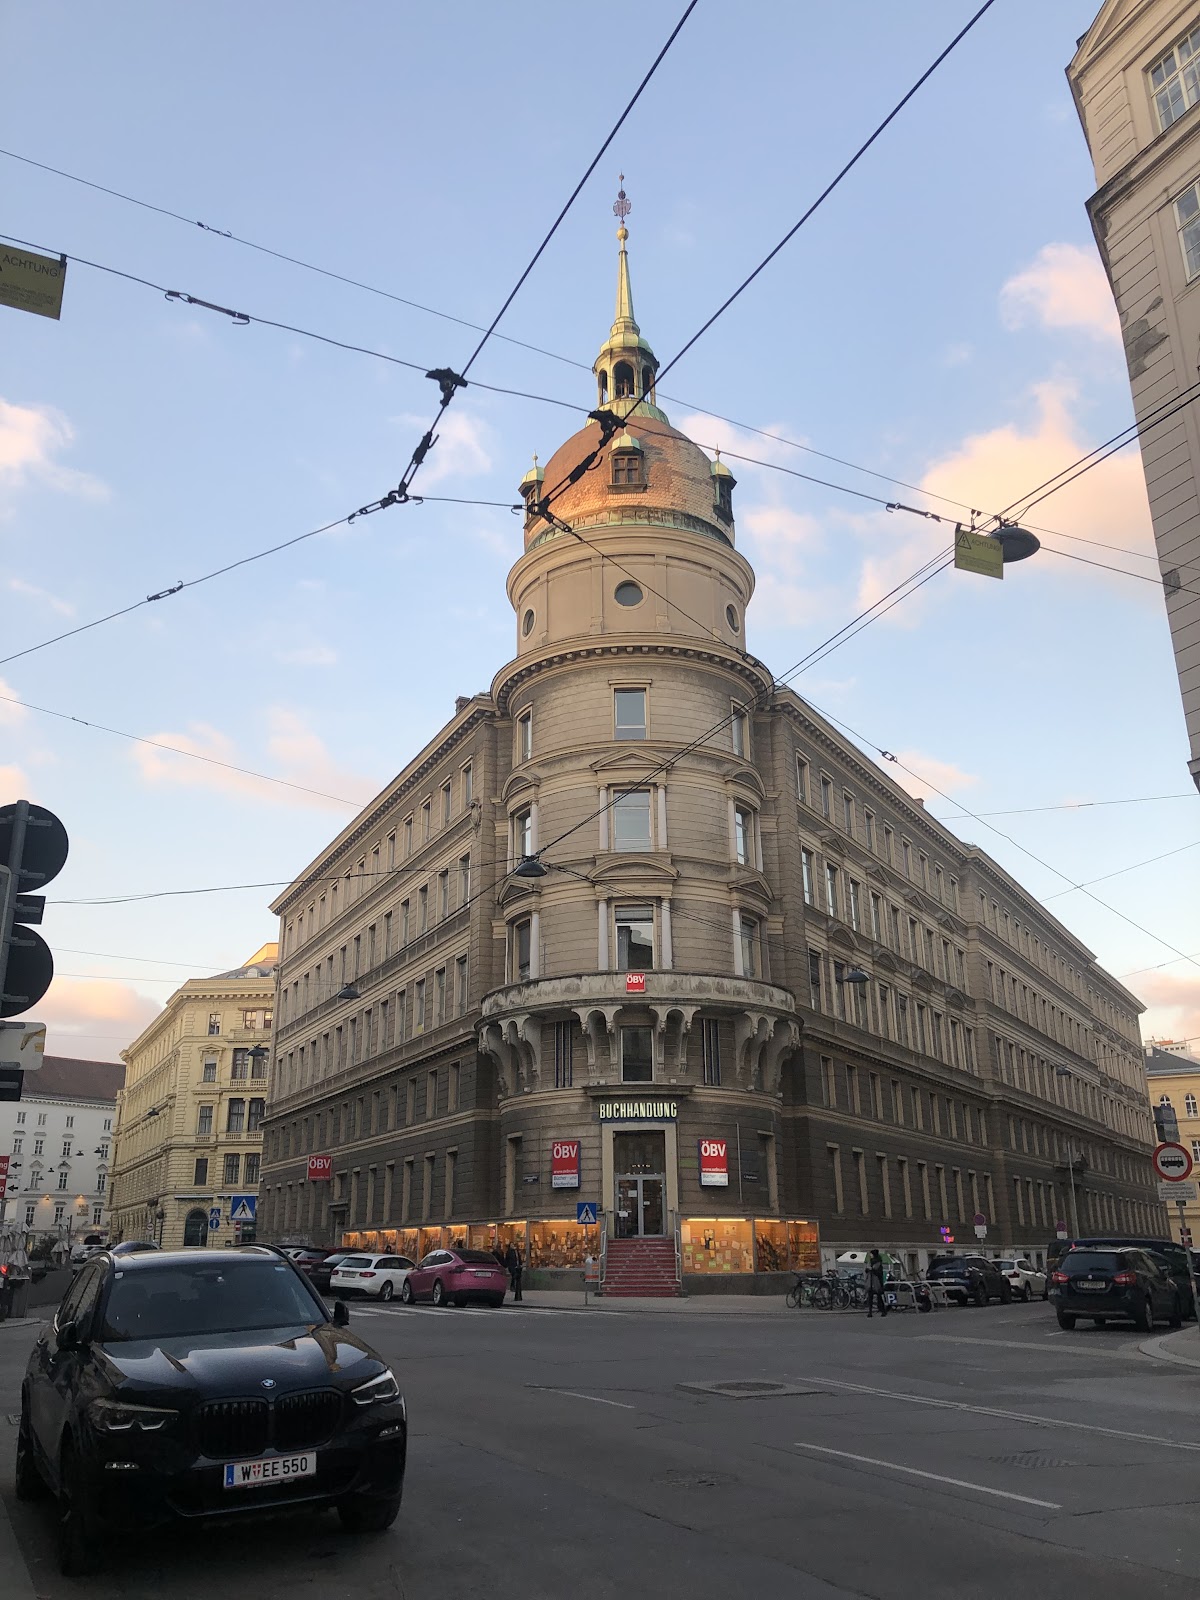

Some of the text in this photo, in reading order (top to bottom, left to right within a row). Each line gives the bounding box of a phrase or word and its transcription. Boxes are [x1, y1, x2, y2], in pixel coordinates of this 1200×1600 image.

[626, 974, 645, 984] ÖBV
[599, 1102, 677, 1119] BUCHHANDLUNG
[553, 1143, 578, 1159] ÖBV
[701, 1140, 726, 1157] ÖBV
[309, 1156, 331, 1169] ÖBV
